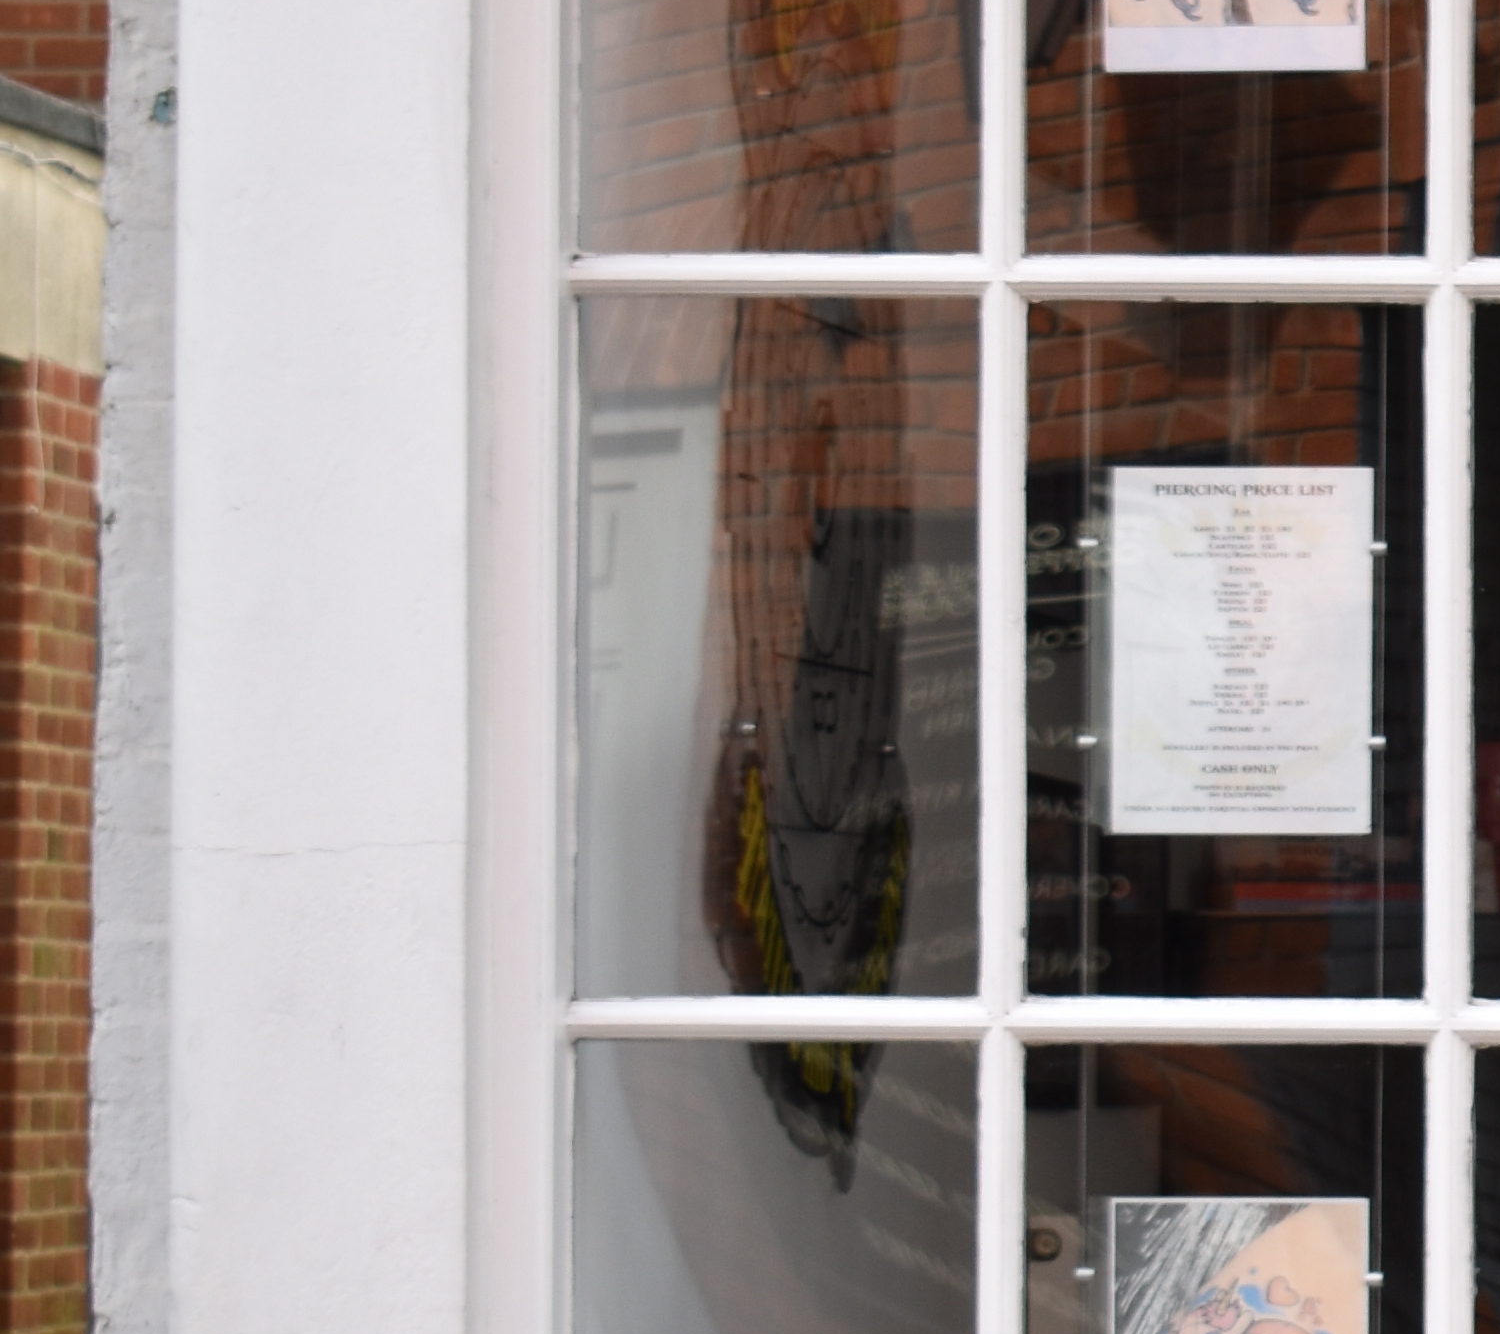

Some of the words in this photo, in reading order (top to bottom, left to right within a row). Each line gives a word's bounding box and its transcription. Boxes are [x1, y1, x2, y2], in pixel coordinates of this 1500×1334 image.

[1154, 484, 1237, 497] PIERCING
[1243, 484, 1294, 497] PRICE
[1300, 484, 1336, 496] LIST
[1201, 764, 1239, 775] CASH
[1242, 764, 1280, 775] ONLY
